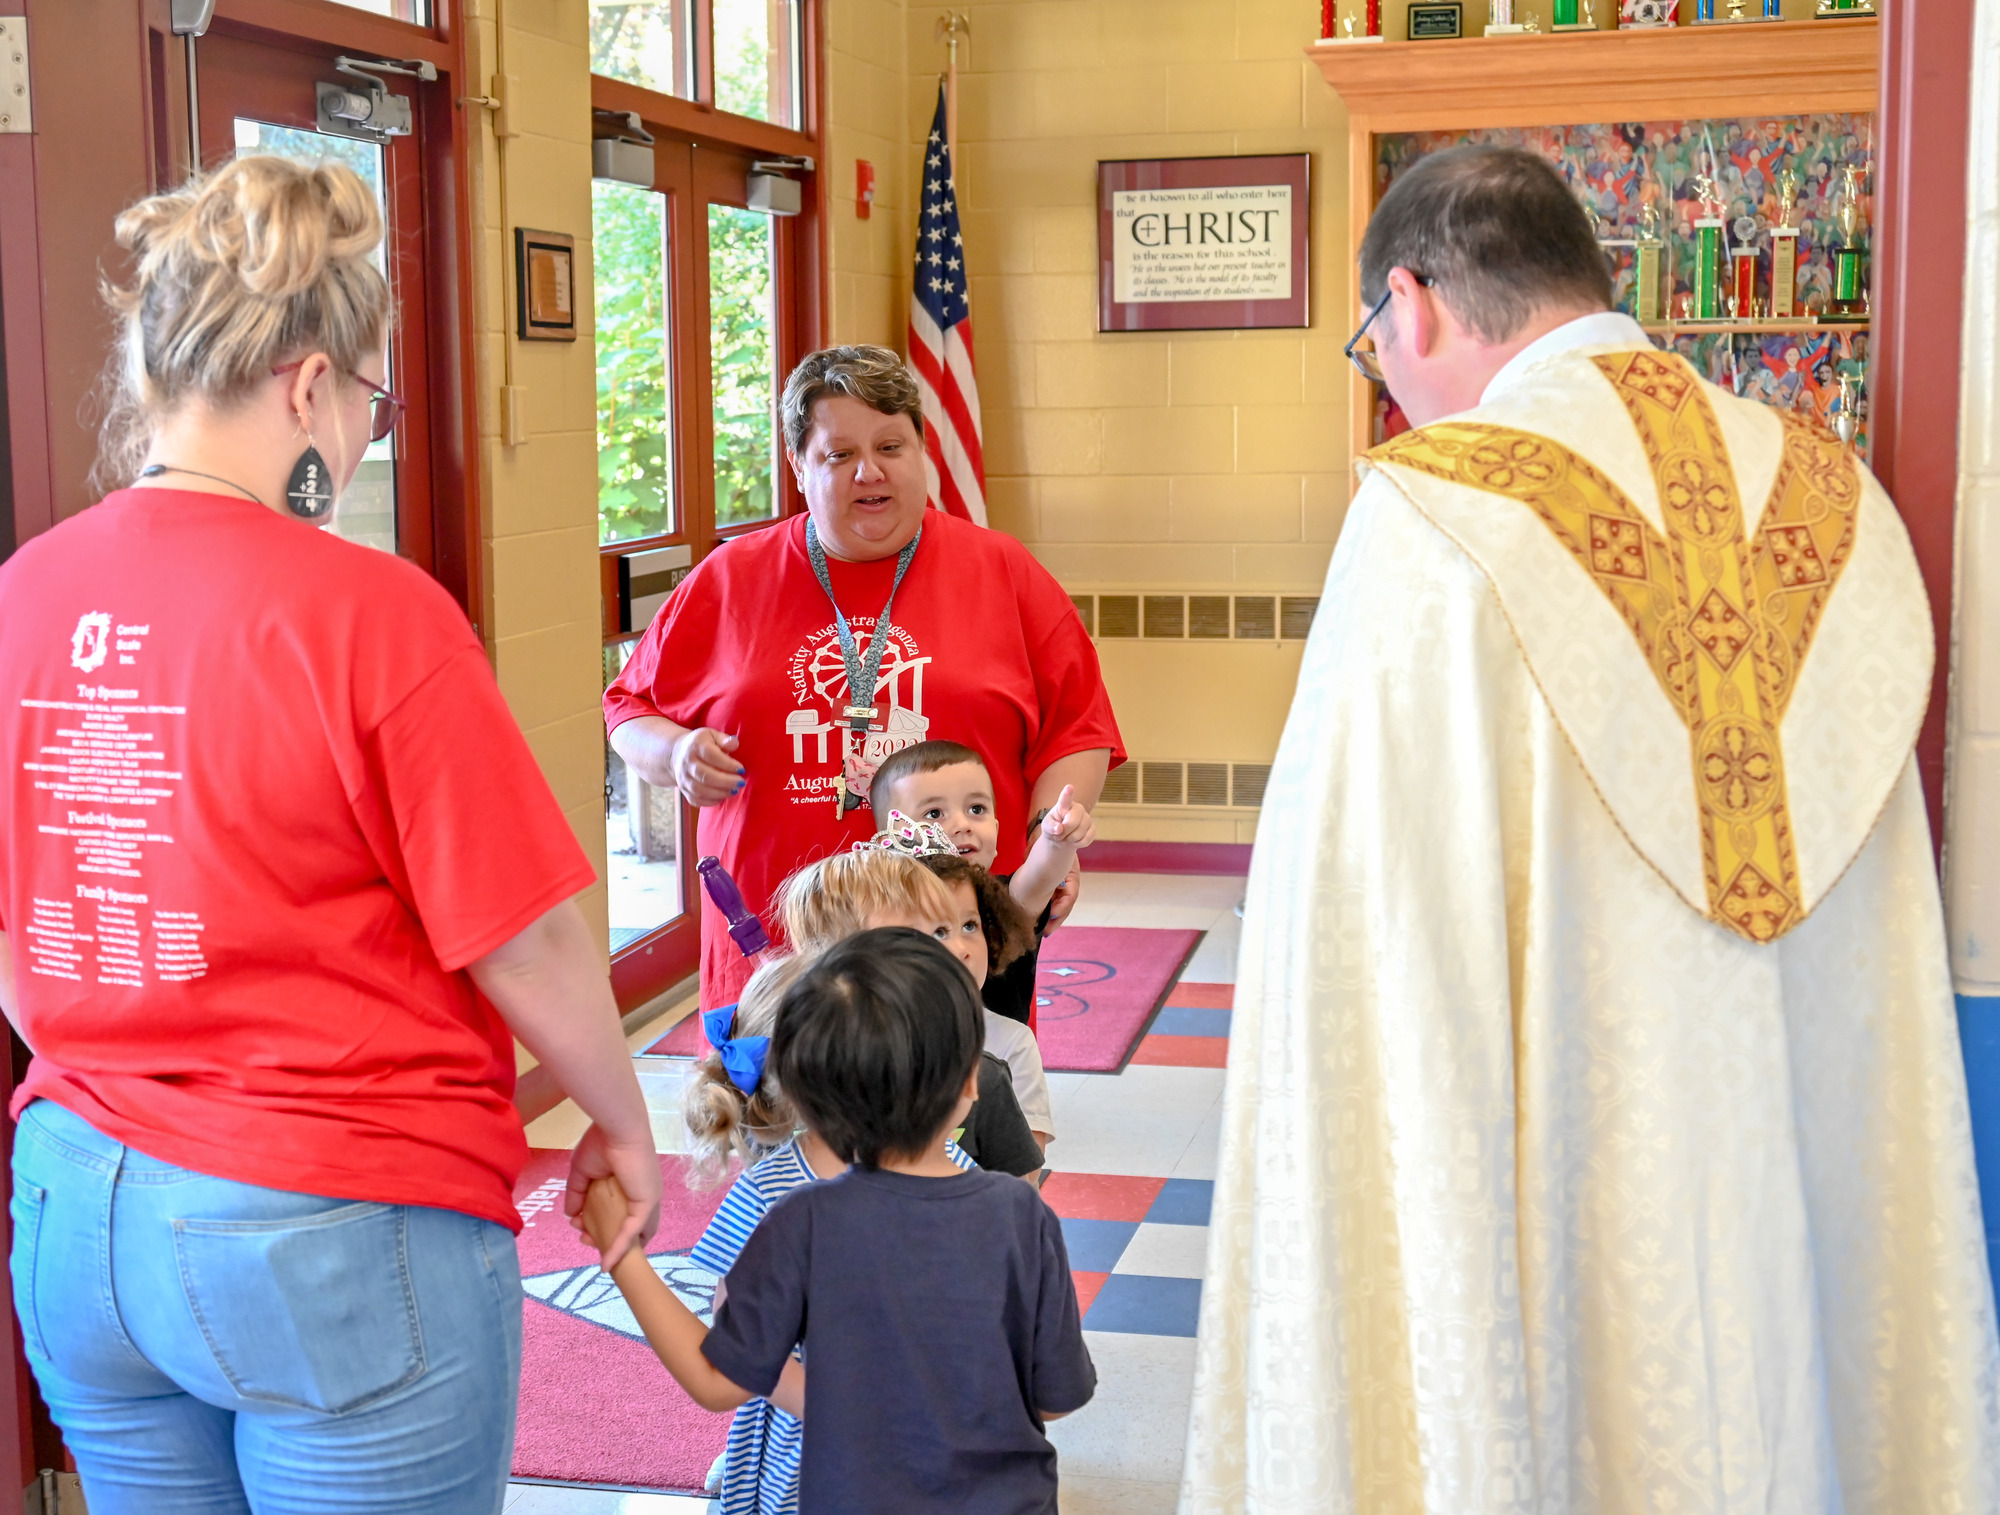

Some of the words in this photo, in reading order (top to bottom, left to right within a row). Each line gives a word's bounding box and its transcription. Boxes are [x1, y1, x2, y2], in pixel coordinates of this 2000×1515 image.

[1150, 192, 1186, 202] known
[1188, 193, 1199, 201] to
[1201, 190, 1213, 200] all
[1216, 190, 1239, 200] who
[1240, 189, 1264, 199] enter
[1267, 188, 1288, 198] here
[1116, 208, 1135, 217] that
[1131, 209, 1279, 247] CHRIST
[1133, 251, 1142, 260] is
[1143, 249, 1159, 261] the
[1162, 251, 1194, 260] reason
[1196, 250, 1210, 260] for
[1214, 248, 1235, 258] this
[1154, 262, 1167, 272] the
[1133, 286, 1148, 297] and
[1150, 286, 1163, 297] the
[306, 464, 318, 479] 2
[305, 498, 317, 512] 4
[787, 645, 813, 706] Nativity
[77, 684, 97, 701] Top
[800, 795, 832, 805] cheerful
[67, 811, 106, 826] Festival
[105, 813, 147, 830] Sponsors
[76, 884, 105, 903] Family
[107, 887, 148, 904] Sponsors
